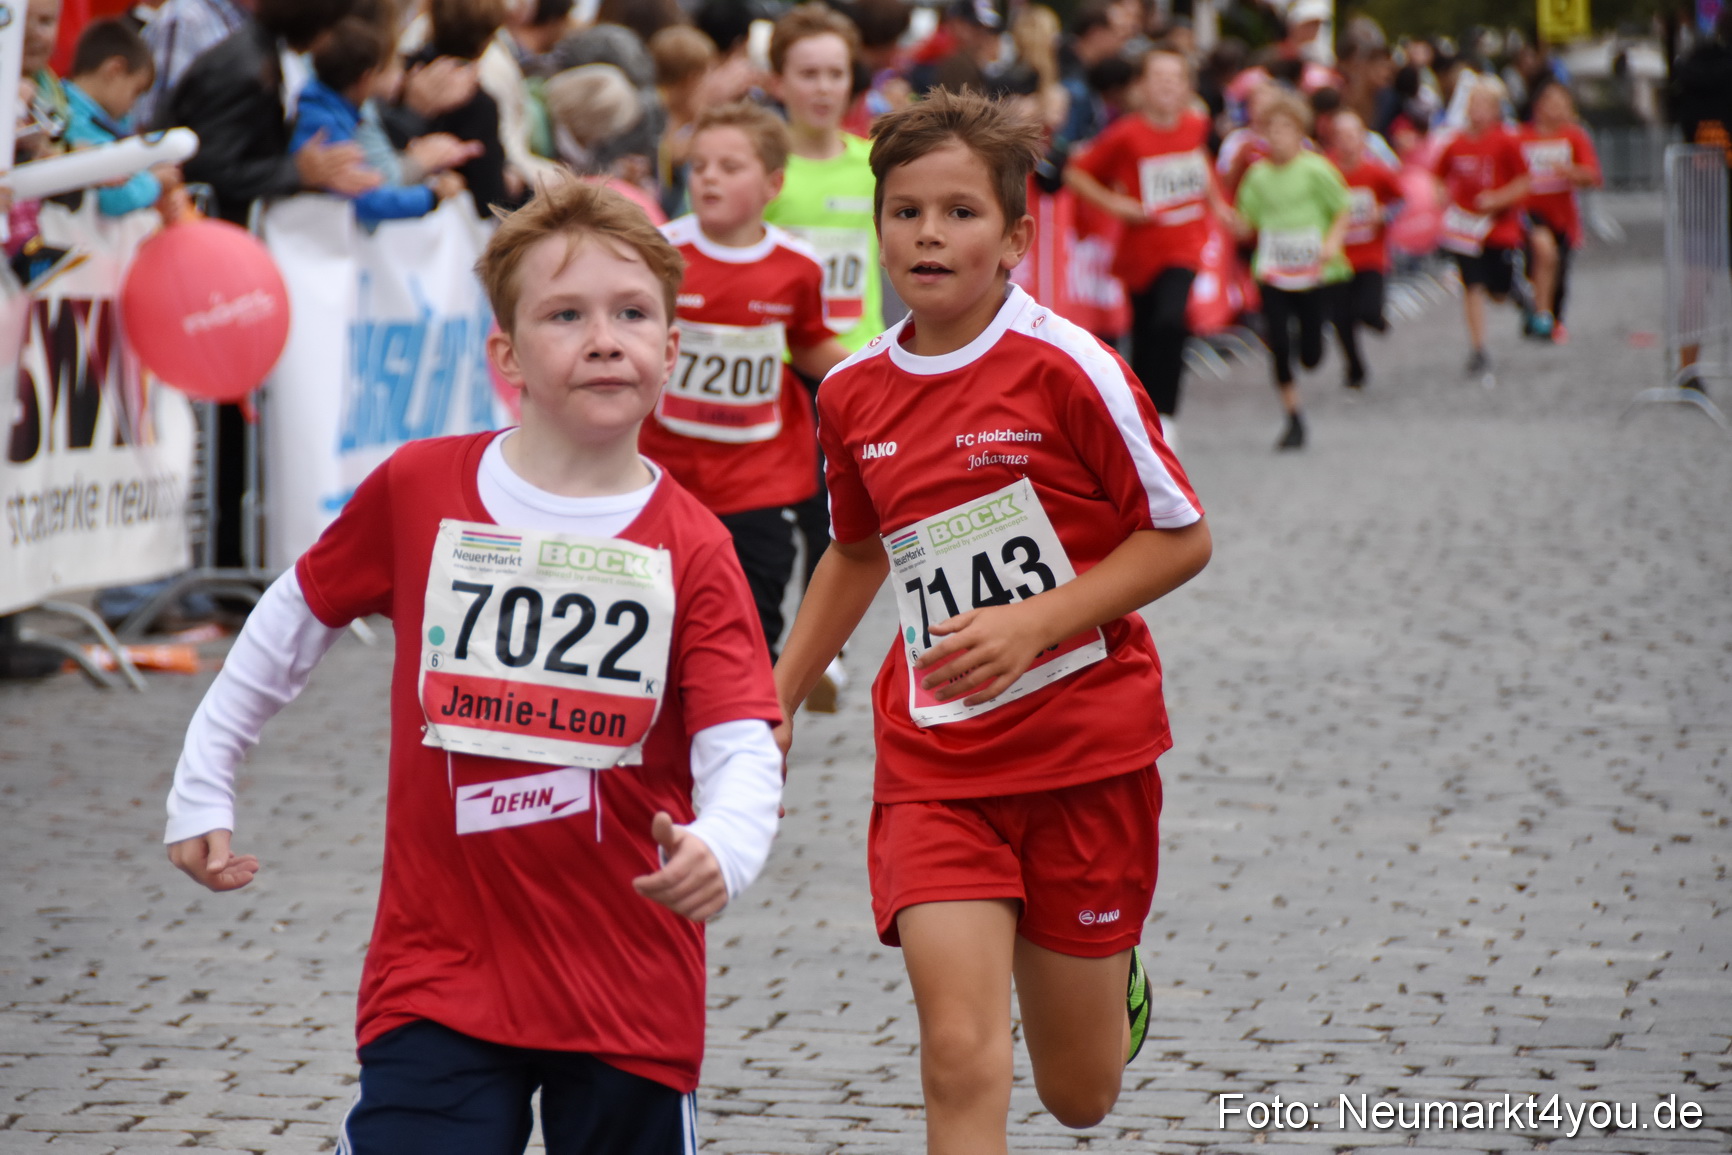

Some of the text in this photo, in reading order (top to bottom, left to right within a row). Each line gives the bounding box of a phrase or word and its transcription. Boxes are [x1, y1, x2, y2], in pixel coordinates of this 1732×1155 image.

[679, 351, 775, 396] 7200
[862, 441, 897, 460] JAKO
[955, 429, 1042, 448] FC Holzheim
[967, 450, 1029, 471] Johannes
[927, 493, 1024, 548] BOCK
[935, 515, 1028, 556] inspired by smart concepts
[452, 548, 523, 567] NeuerMarkt
[538, 540, 653, 580] BOCK
[893, 546, 926, 568] NeuerMarkt
[905, 535, 1057, 650] 7143
[451, 579, 650, 682] 7022
[431, 653, 438, 668] 6
[645, 679, 655, 694] K
[441, 685, 627, 738] Jamie-Leon
[490, 786, 554, 816] DEHN
[1096, 908, 1120, 924] JAKO
